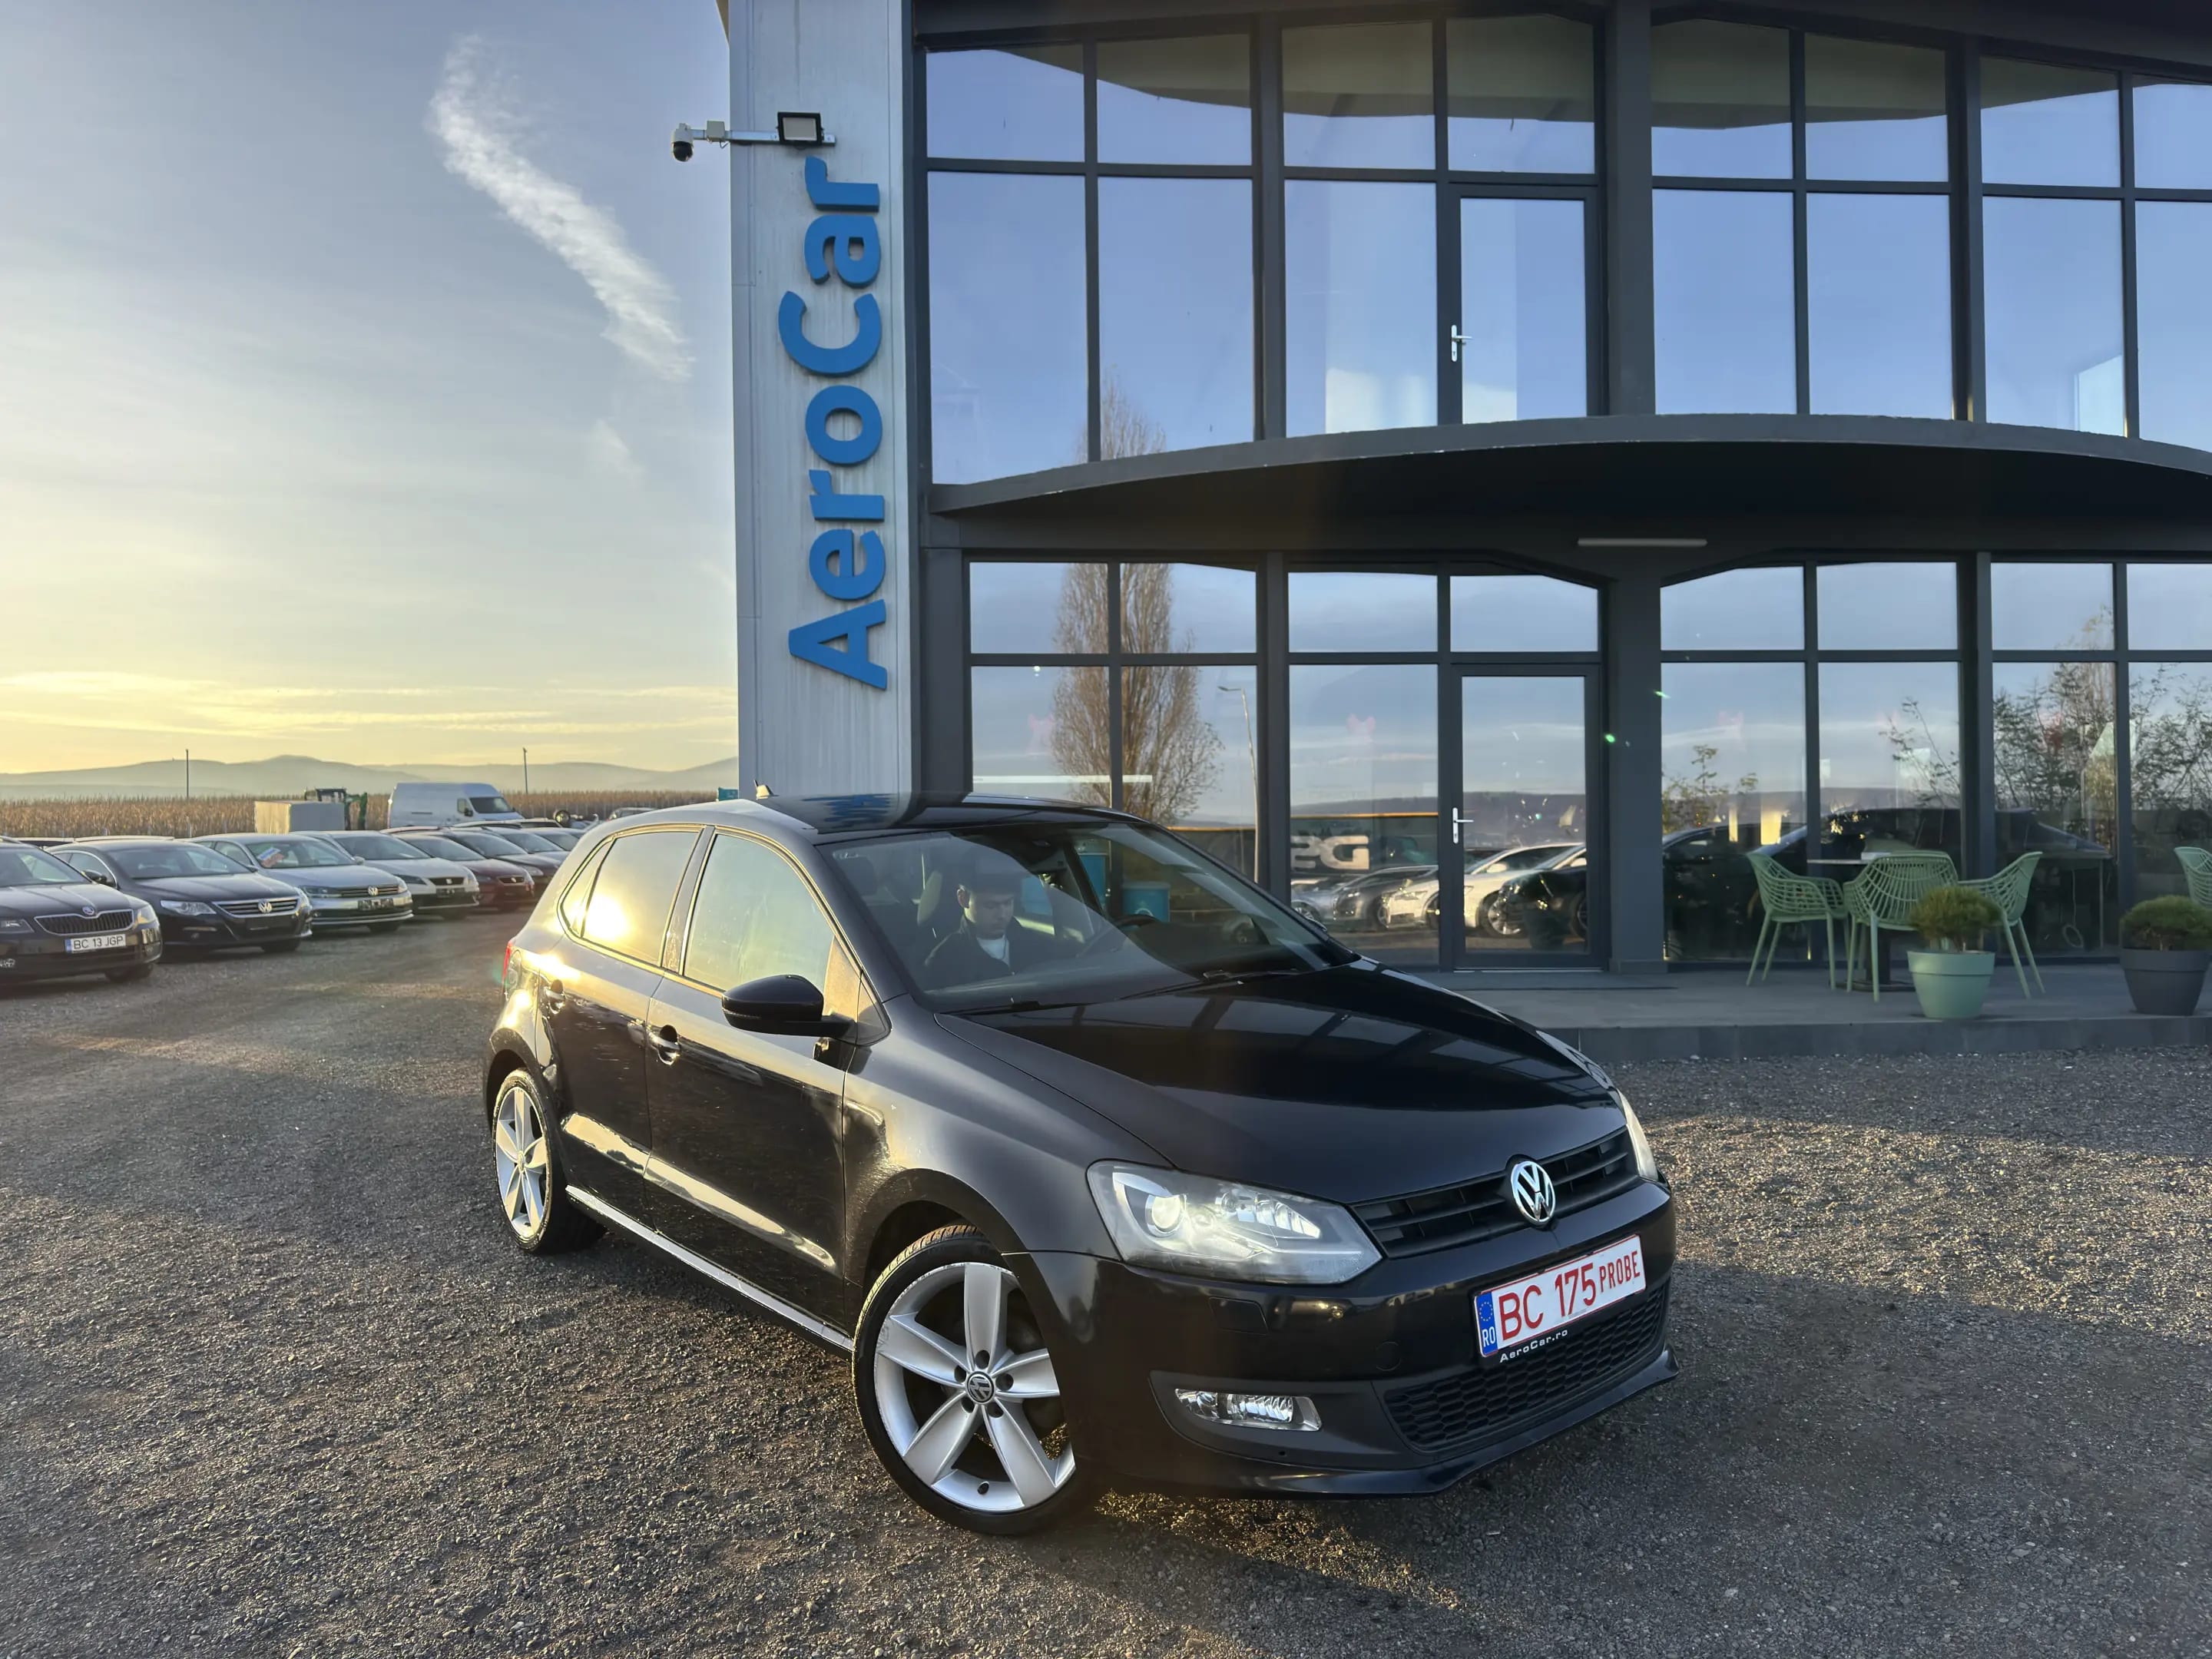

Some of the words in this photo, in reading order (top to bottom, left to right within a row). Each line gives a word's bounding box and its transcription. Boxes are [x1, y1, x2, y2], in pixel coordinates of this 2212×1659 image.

[778, 155, 888, 690] AeroCar
[73, 939, 88, 949] BC
[92, 938, 102, 948] 13
[104, 935, 124, 946] JGP
[1498, 1284, 1544, 1341] BC
[1555, 1262, 1597, 1318] 175
[1599, 1250, 1641, 1293] PROBE
[1482, 1326, 1496, 1347] RO
[1499, 1330, 1568, 1363] AeroCar.ro
